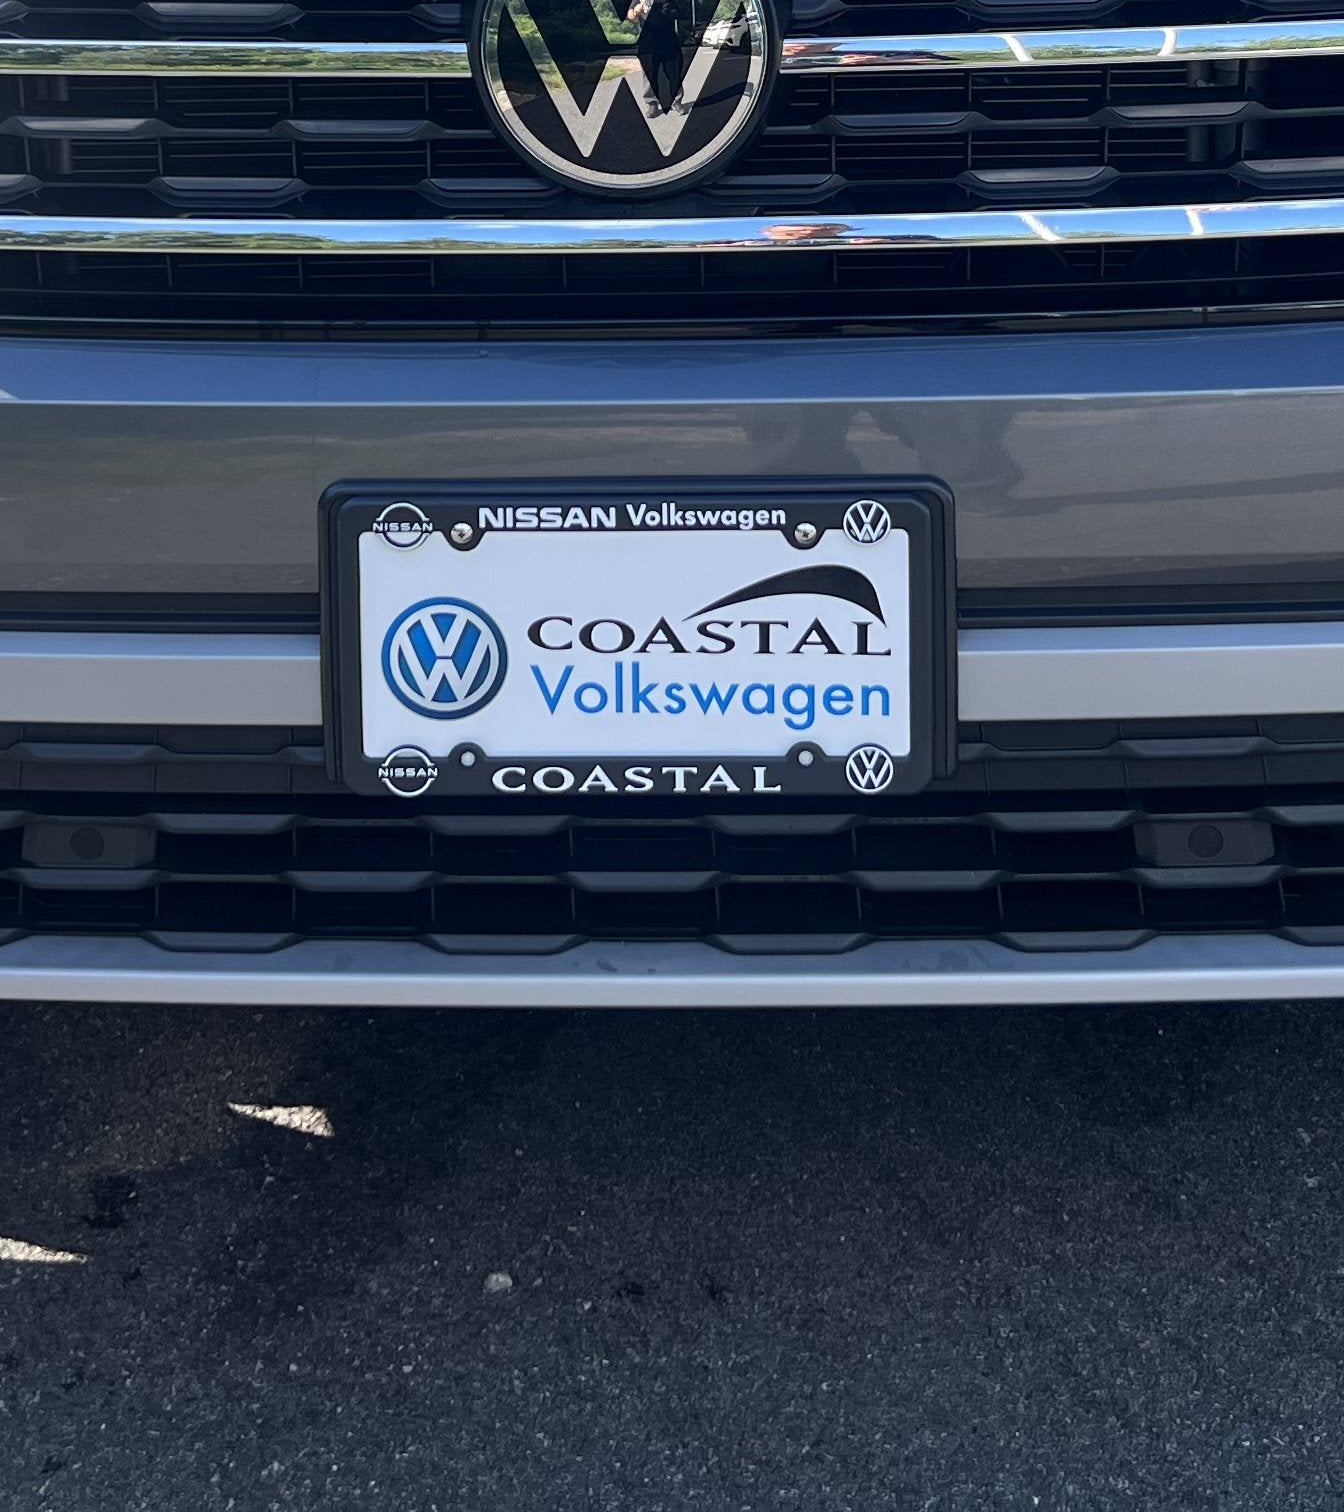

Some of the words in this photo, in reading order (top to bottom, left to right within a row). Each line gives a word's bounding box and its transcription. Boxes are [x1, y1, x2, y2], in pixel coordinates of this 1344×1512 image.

[372, 520, 433, 533] NISSAN
[478, 506, 616, 529] NISSAN
[625, 503, 787, 530] Volkswagen
[844, 500, 891, 544] VW
[527, 616, 892, 656] COASTAL
[388, 602, 502, 714] VW
[530, 661, 891, 731] Volkswagen
[377, 766, 439, 779] NISSAN
[491, 765, 782, 793] COASTAL
[846, 747, 894, 792] VW
